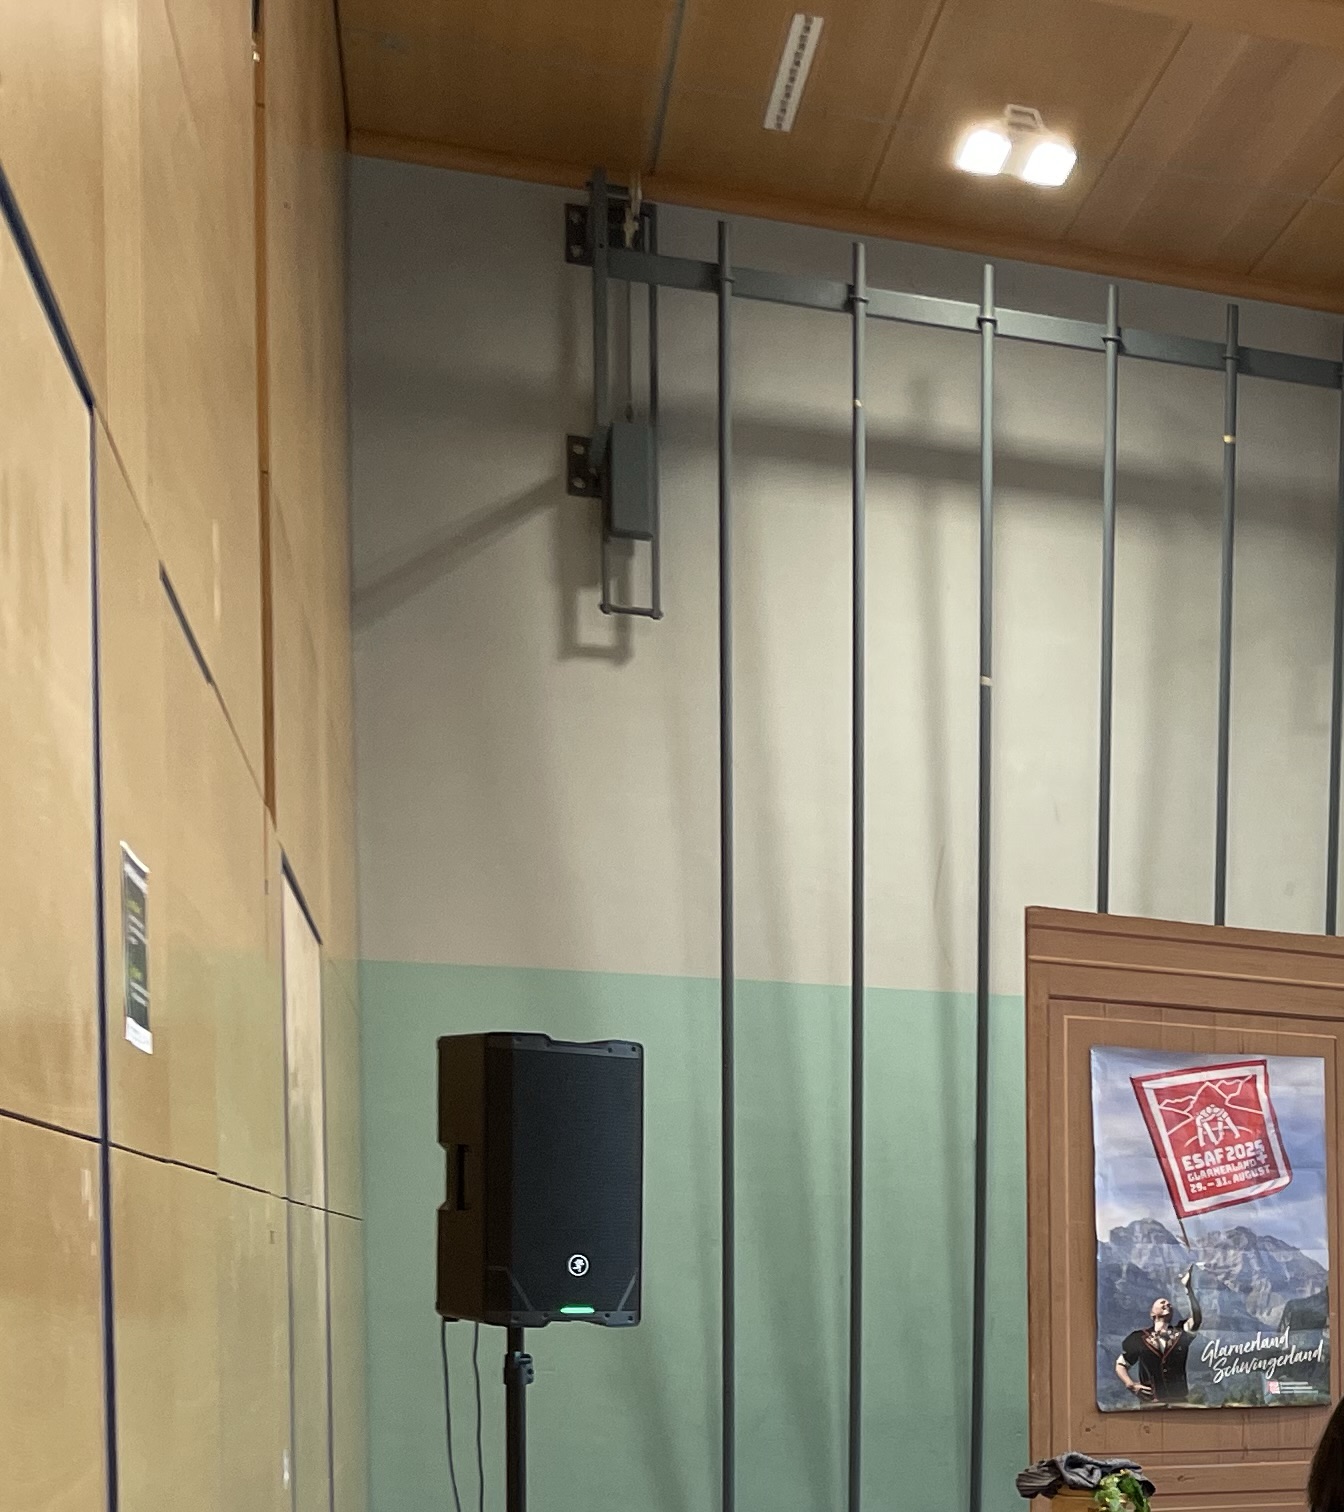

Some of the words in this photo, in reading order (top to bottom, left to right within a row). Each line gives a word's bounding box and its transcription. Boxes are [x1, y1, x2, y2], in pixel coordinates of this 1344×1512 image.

[1181, 1147, 1224, 1172] ESAF
[1224, 1139, 1265, 1162] 2025
[1187, 1158, 1257, 1183] GLARNERLAND
[1232, 1164, 1271, 1184] AUGUST
[1201, 1325, 1290, 1368] Glarnerland
[1213, 1339, 1324, 1384] Schwingerland
